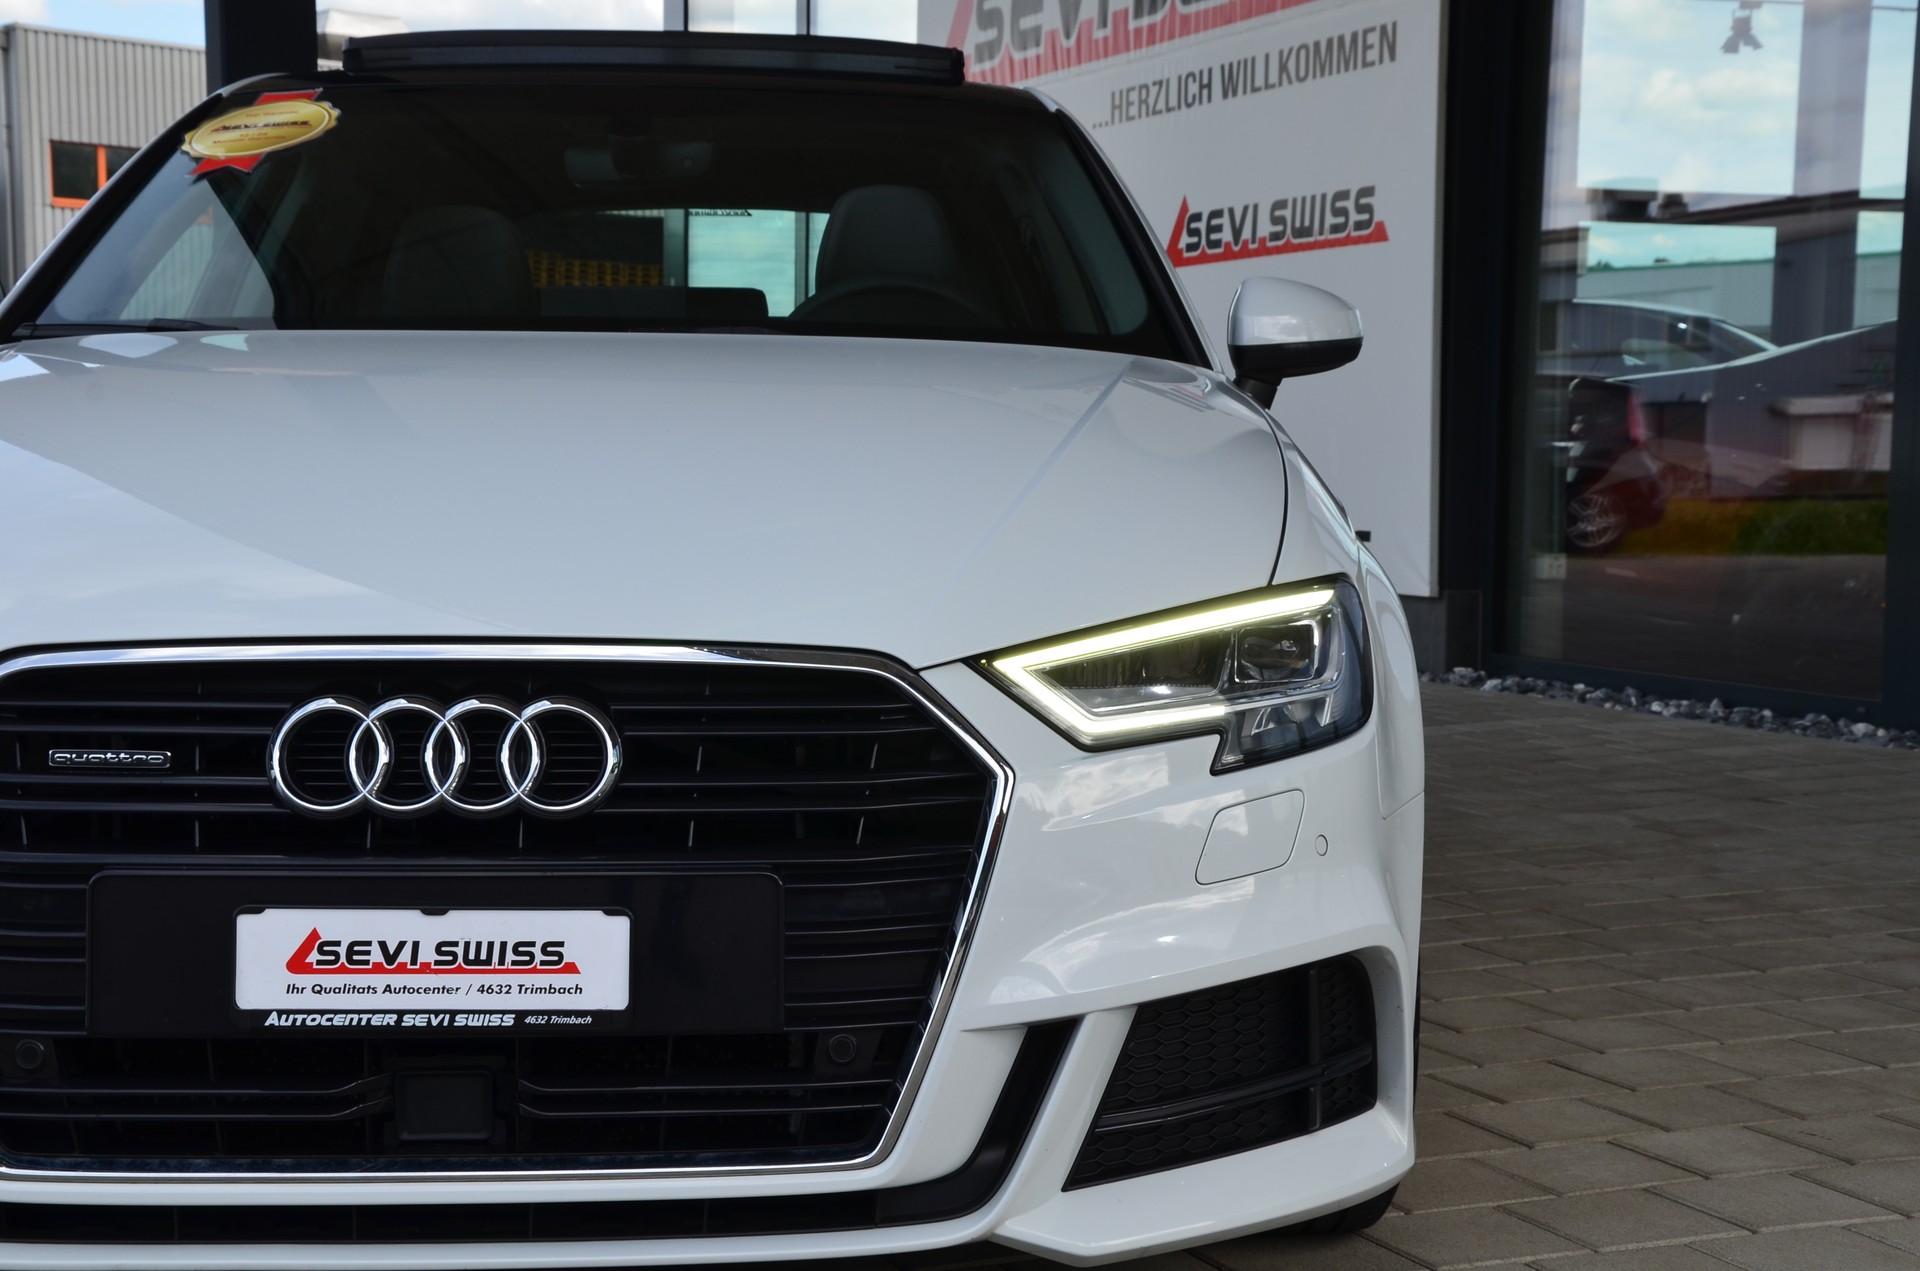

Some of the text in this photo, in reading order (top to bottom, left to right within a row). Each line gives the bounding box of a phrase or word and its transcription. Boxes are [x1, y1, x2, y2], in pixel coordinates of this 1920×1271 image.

[1220, 20, 1398, 101] WILLKOMMEN
[1185, 185, 1376, 254] SEVI SWISS
[53, 752, 165, 764] quattro
[315, 940, 566, 967] SEVI SWISS
[286, 983, 307, 995] Ihr
[311, 983, 378, 995] Qualitats
[382, 983, 462, 995] Autocenter
[476, 983, 513, 995] 4632
[517, 983, 583, 995] Trimbach
[401, 1013, 450, 1027] SEVI
[453, 1013, 516, 1027] SWISS
[523, 1015, 548, 1026] 4632
[550, 1015, 593, 1026] Trimbach
